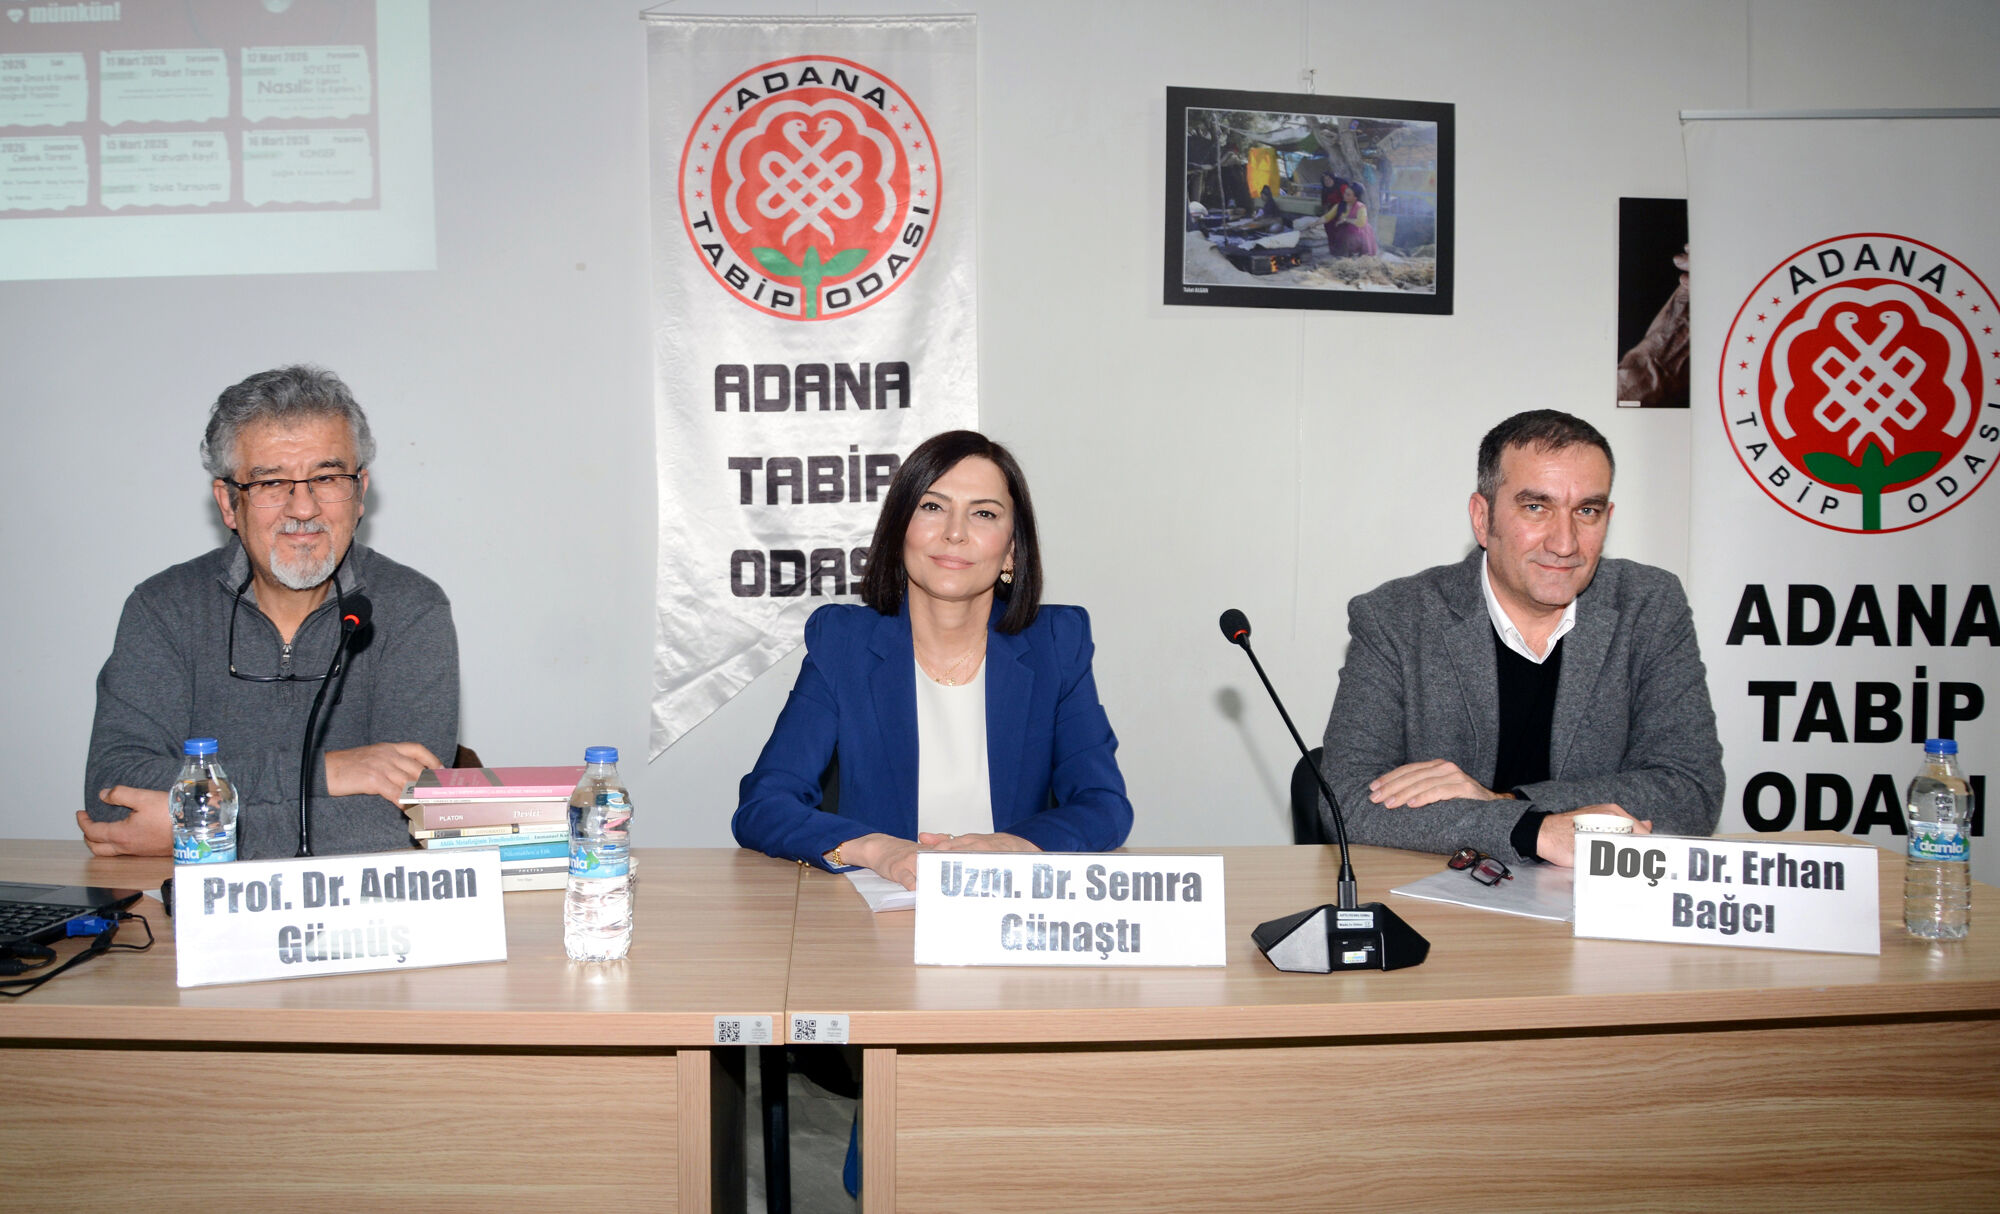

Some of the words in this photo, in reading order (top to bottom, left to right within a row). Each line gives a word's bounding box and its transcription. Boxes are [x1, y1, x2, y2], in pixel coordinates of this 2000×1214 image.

[28, 1, 121, 23] mümkün!
[736, 66, 886, 111] ADANA
[693, 211, 795, 310] TABİP
[826, 206, 931, 310] ODASI
[1789, 243, 1947, 295] ADANA
[714, 361, 911, 412] ADANA
[728, 444, 901, 505] TABİP
[1736, 412, 1839, 514] TABİP
[1908, 402, 2000, 513] ODASI
[730, 547, 872, 597] ODAS
[1726, 584, 2000, 647] ADANA
[1748, 665, 1985, 743] TABİP
[439, 814, 464, 822] PLATON
[1742, 771, 1986, 837] ODAI
[1688, 847, 1733, 884] Dr.
[1742, 850, 1845, 891] Erhan
[1919, 840, 1964, 854] damla
[203, 873, 292, 915] Prof.
[302, 869, 350, 909] Dr.
[360, 866, 478, 905] Adnan
[940, 860, 1021, 899] Uzm.
[1032, 863, 1076, 900] Dr.
[1086, 863, 1202, 902] Semra
[1001, 912, 1141, 961] Günaştı
[1672, 892, 1776, 935] Bağcı
[278, 917, 412, 964] Gümüş
